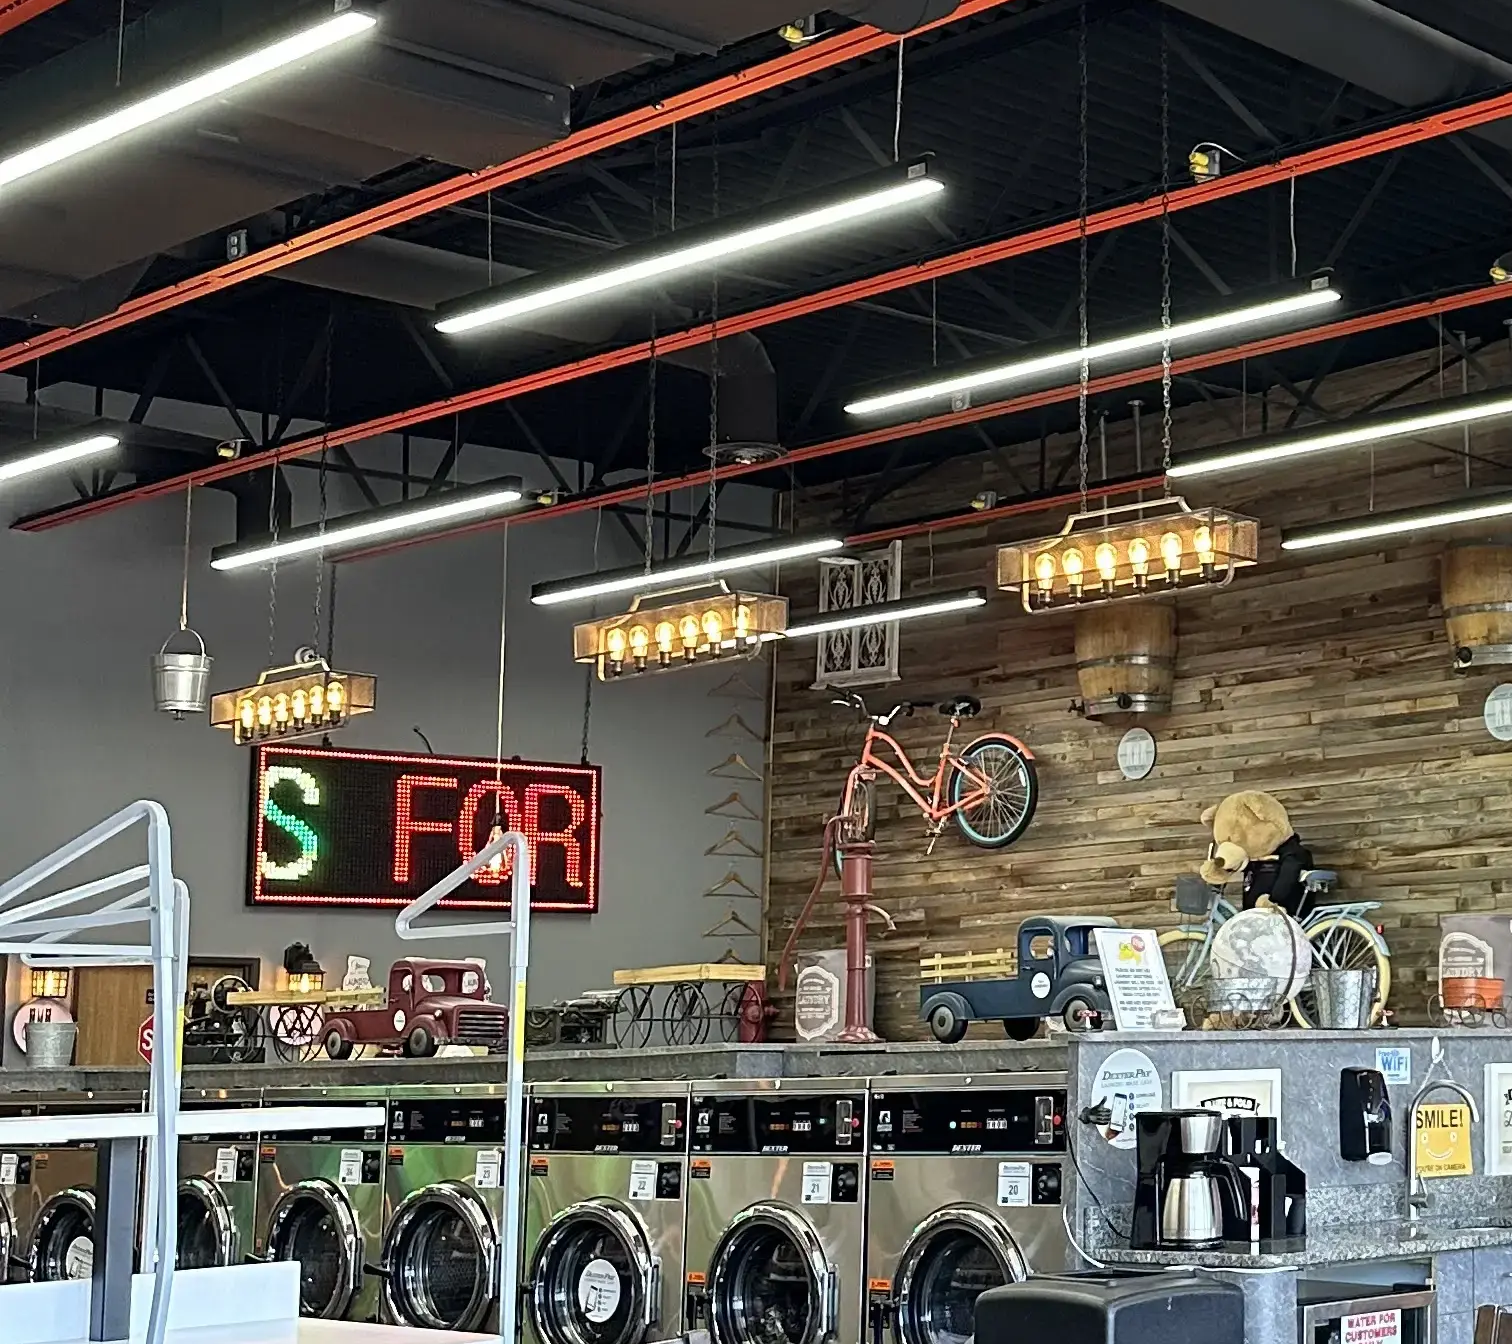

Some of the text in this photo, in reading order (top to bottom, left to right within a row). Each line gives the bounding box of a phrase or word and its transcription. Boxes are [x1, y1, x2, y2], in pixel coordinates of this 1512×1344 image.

[394, 774, 586, 889] FOR
[1416, 1109, 1464, 1129] SMILE!
[594, 1144, 619, 1152] DEXTER
[952, 1144, 982, 1152] DEXTER
[1444, 1162, 1467, 1170] CAMERA
[637, 1181, 646, 1191] 22
[811, 1183, 820, 1194] 21
[1008, 1185, 1019, 1196] 20
[1347, 1312, 1396, 1328] WATER FOR
[1345, 1325, 1398, 1343] CUSTOMERS
